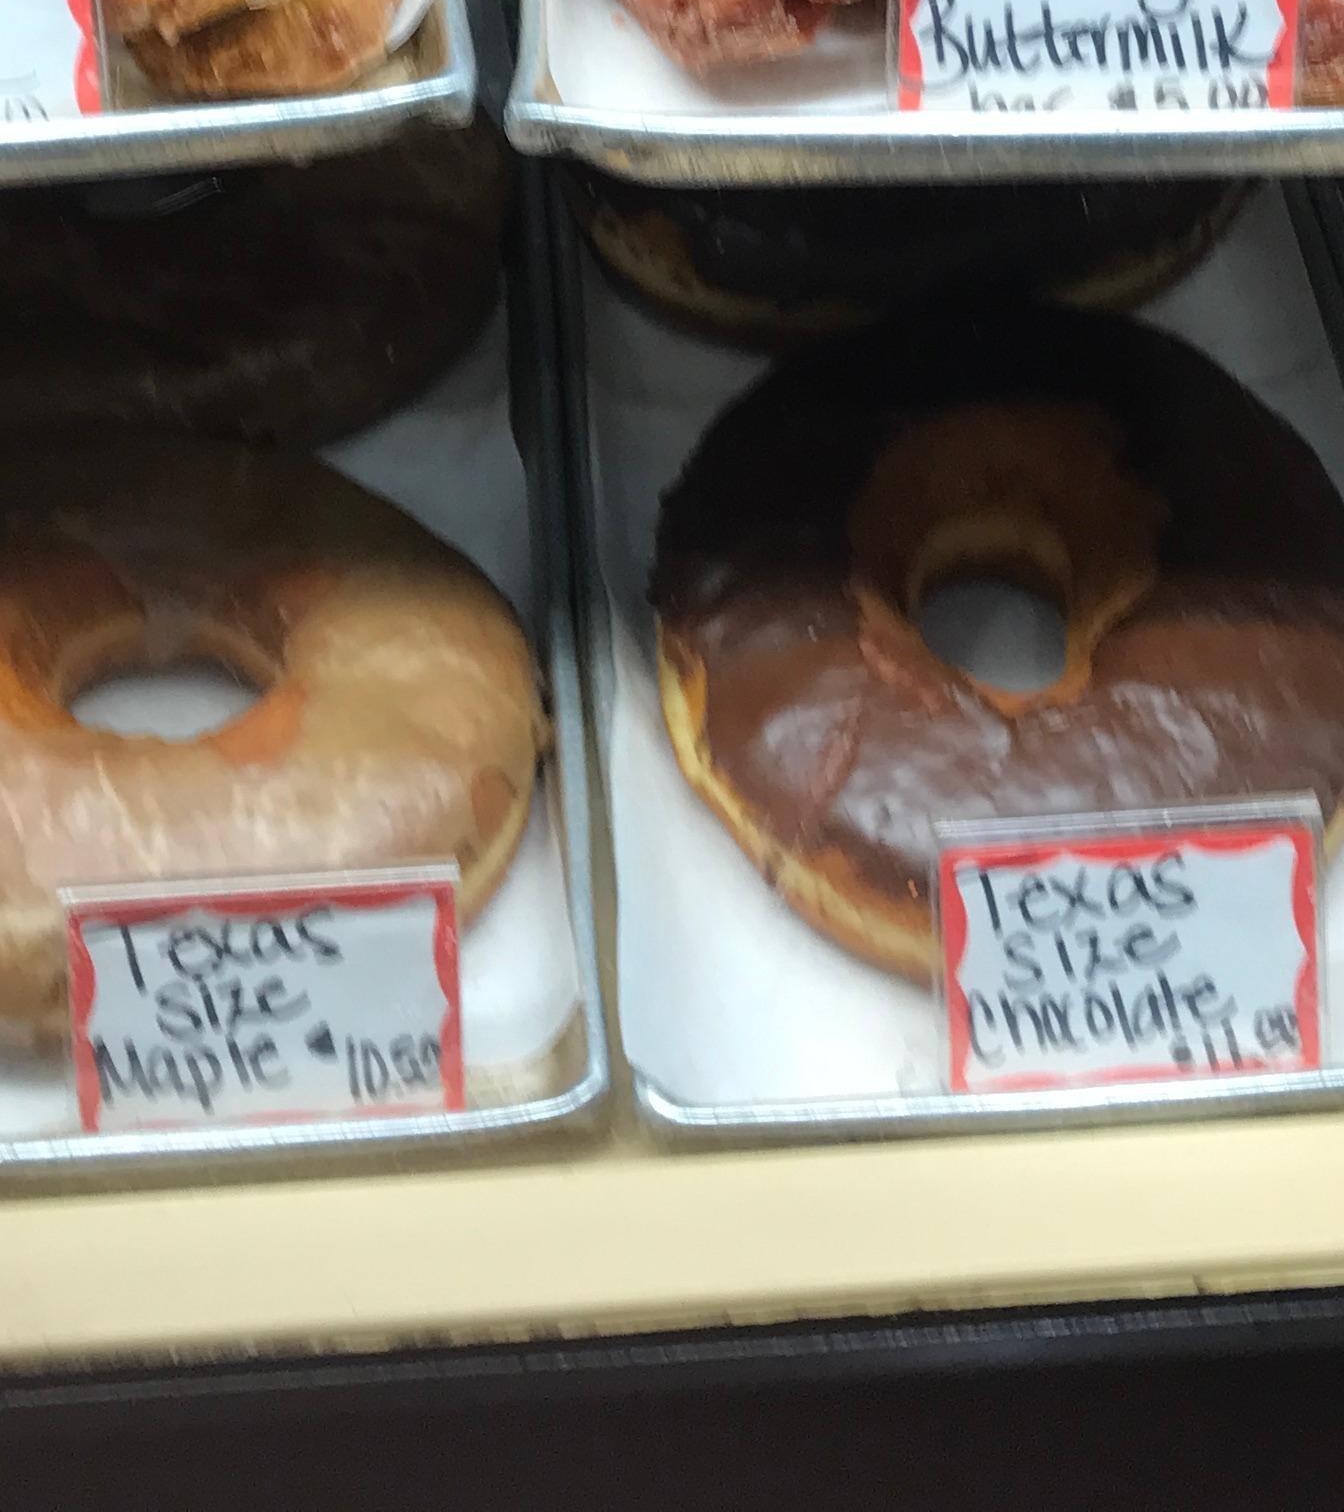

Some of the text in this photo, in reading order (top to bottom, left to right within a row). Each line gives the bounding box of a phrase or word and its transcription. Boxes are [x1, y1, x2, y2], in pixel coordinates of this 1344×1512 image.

[959, 851, 1196, 939] Texas
[84, 906, 342, 994] Texas
[969, 970, 1237, 1067] Chocolate
[93, 1032, 290, 1113] Maple
